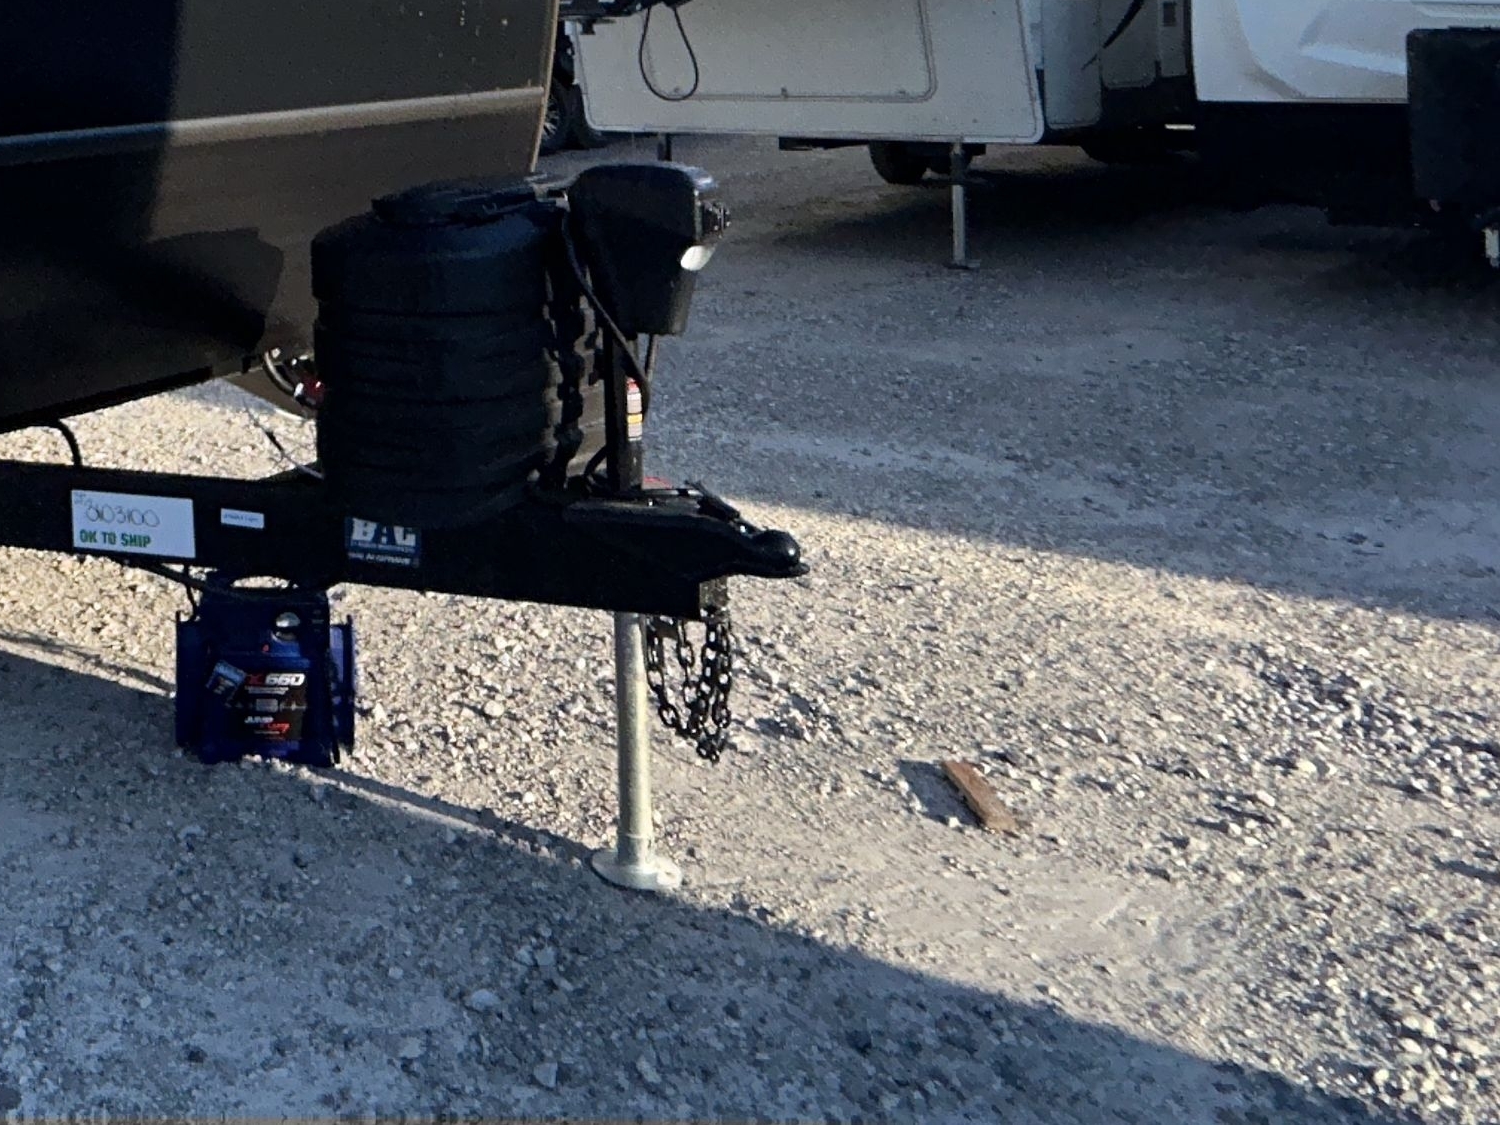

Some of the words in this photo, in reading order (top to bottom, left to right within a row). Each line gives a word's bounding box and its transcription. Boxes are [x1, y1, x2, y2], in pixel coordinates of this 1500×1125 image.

[79, 528, 98, 544] OK
[101, 531, 117, 546] TO
[120, 532, 152, 548] SHIP
